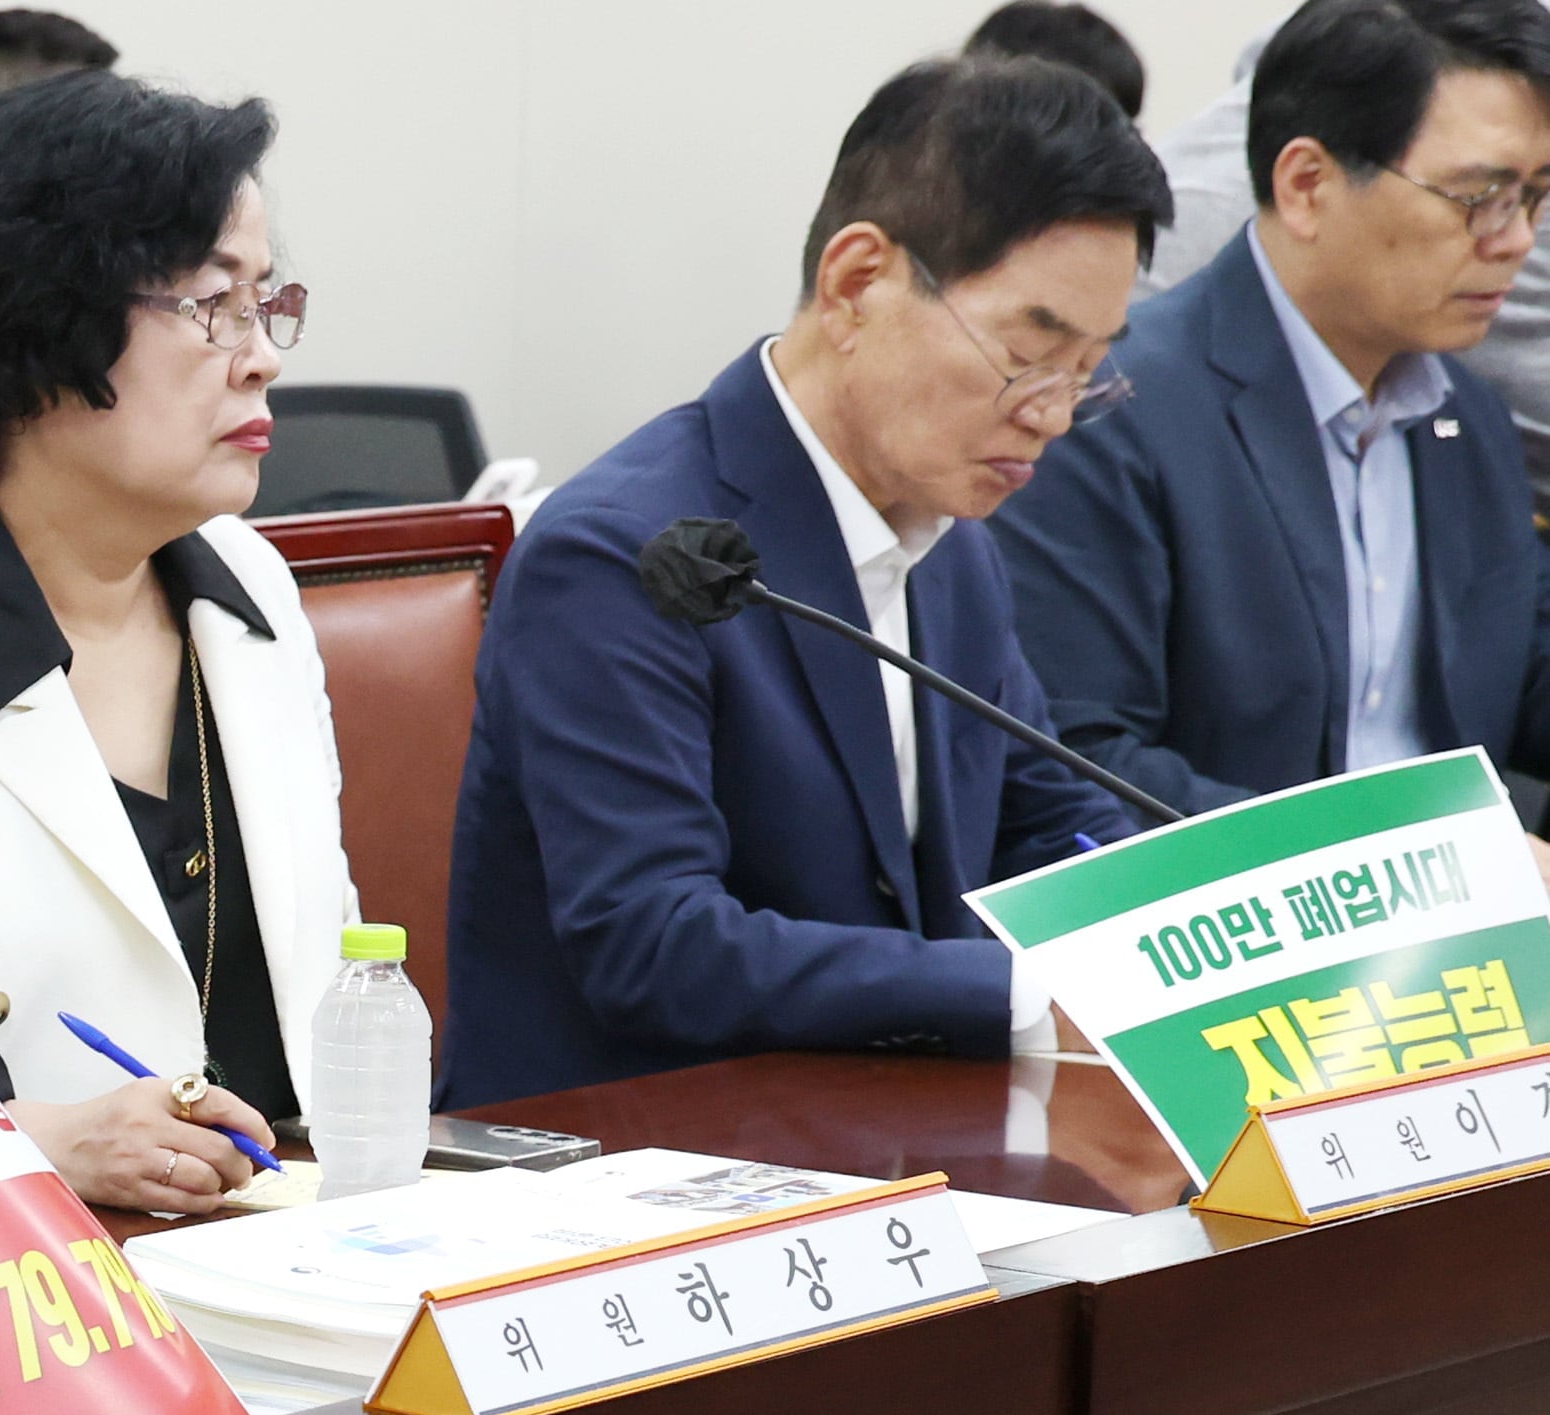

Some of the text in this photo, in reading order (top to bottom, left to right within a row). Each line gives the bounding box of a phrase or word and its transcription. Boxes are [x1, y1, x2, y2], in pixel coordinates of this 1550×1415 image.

[1137, 839, 1472, 989] 100만 폐업시대
[502, 1217, 930, 1374] 위원 하상우
